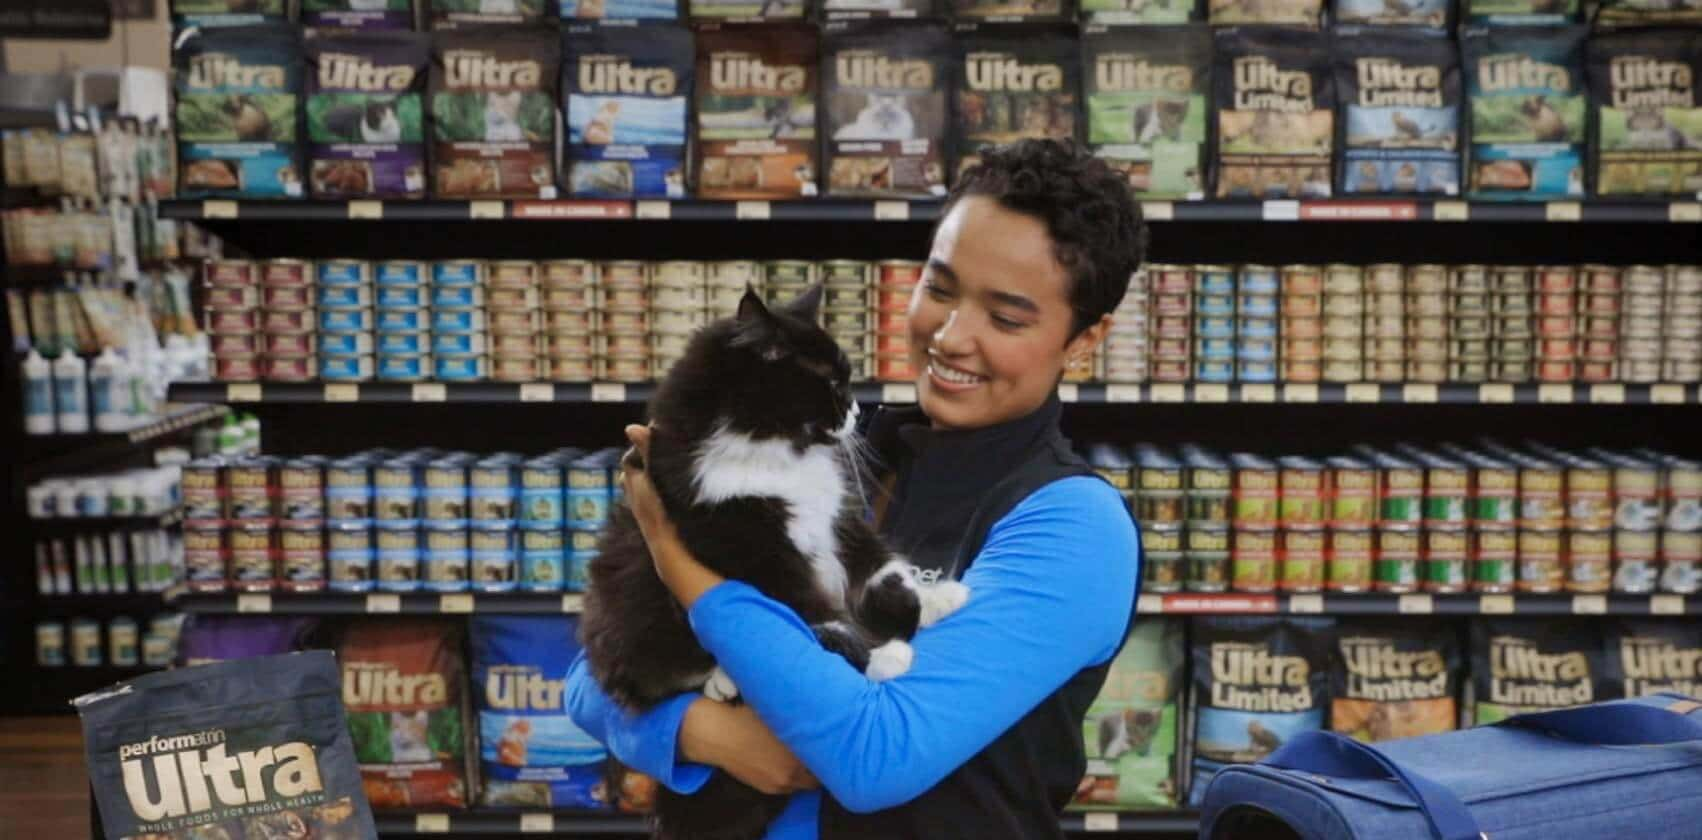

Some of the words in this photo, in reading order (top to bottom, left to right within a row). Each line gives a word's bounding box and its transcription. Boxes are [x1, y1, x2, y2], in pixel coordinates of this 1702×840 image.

[487, 670, 565, 709] ultr
[138, 821, 175, 833] WHOLE
[179, 812, 219, 826] FOODS
[223, 807, 244, 817] FOR
[247, 802, 283, 813] WHOLE
